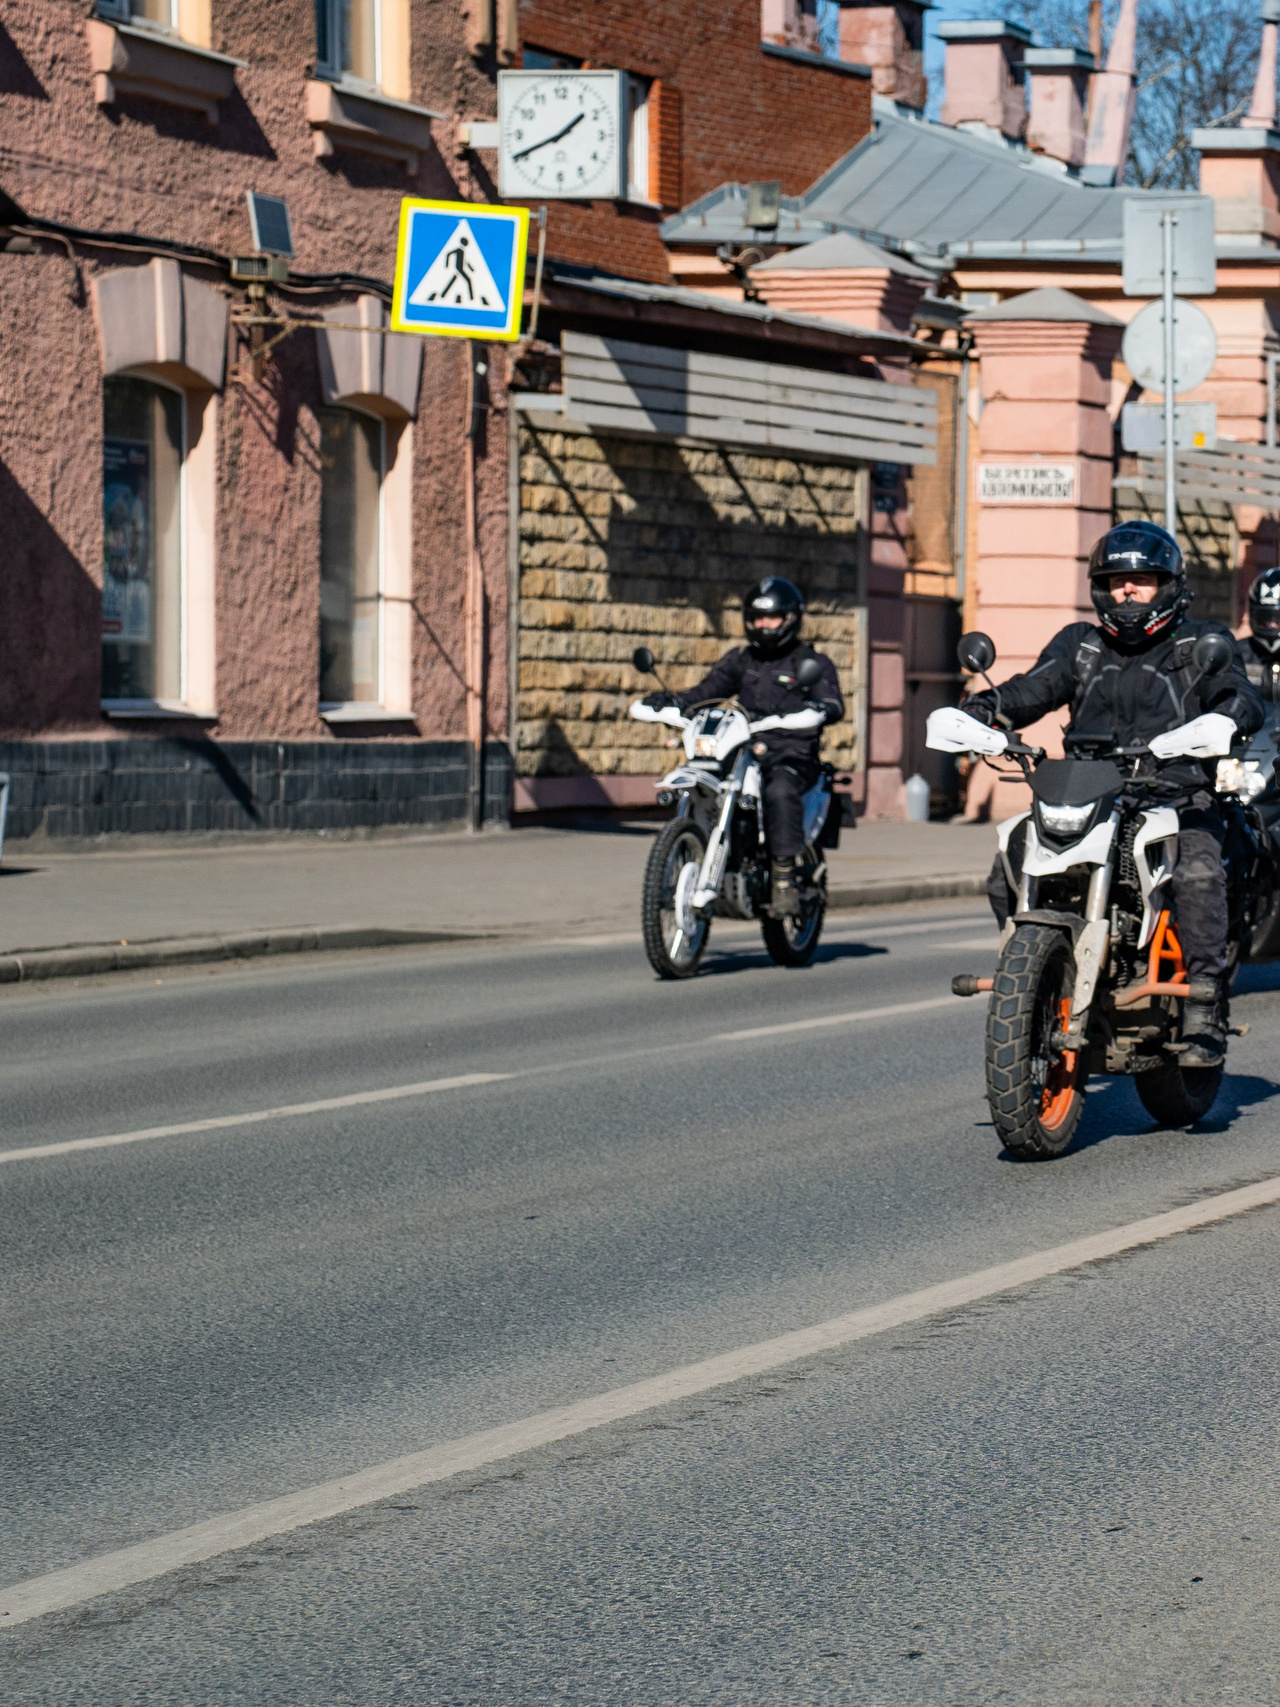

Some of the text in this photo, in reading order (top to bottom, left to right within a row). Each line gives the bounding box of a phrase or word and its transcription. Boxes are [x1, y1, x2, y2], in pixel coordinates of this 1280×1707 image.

[534, 94, 547, 105] 11
[554, 86, 567, 100] 12
[520, 108, 535, 121] 10
